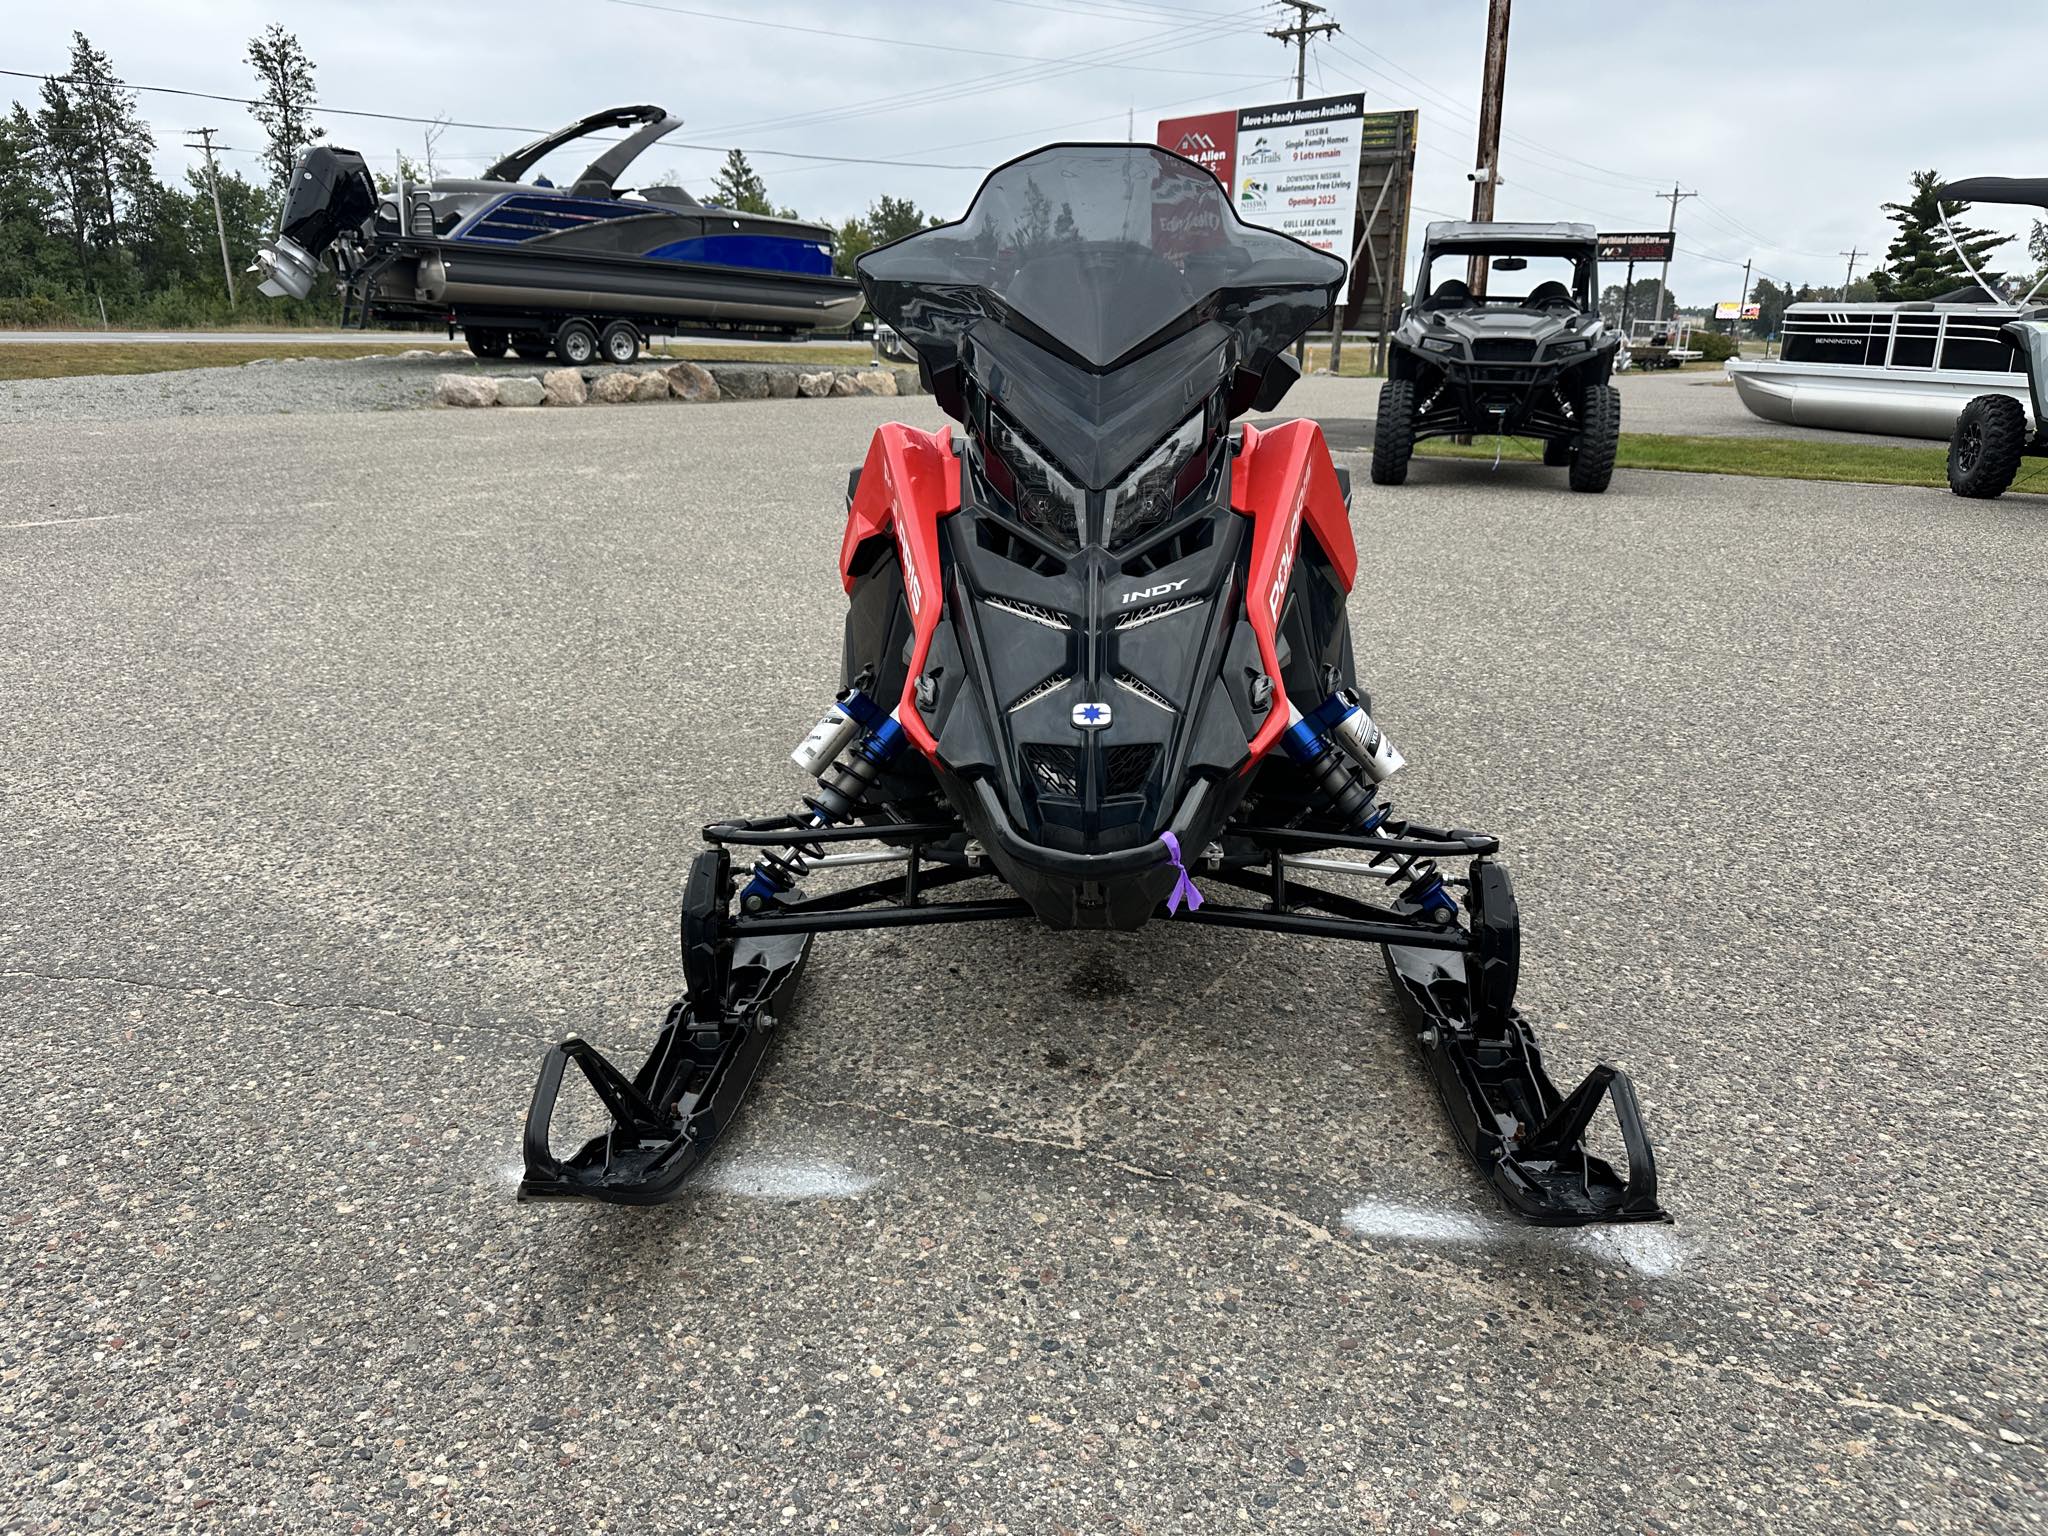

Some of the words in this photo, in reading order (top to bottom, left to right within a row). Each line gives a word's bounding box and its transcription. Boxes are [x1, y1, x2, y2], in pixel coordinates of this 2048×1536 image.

[1242, 111, 1294, 126] Move-in-Ready
[1295, 109, 1319, 120] Homes
[1321, 103, 1357, 117] Available
[1304, 127, 1329, 137] NISSWA
[1285, 140, 1304, 150] Single
[1305, 138, 1326, 148] Family
[1327, 136, 1349, 145] Homes
[1200, 150, 1226, 162] Allen
[1241, 155, 1259, 166] Pine
[1260, 152, 1281, 164] Trails
[1293, 152, 1298, 162] 9
[1300, 150, 1314, 161] Lots
[1315, 148, 1341, 159] remain
[1276, 183, 1316, 193] Maintenance
[1317, 181, 1331, 190] Free
[1331, 180, 1351, 191] Living
[1288, 196, 1317, 208] Opening
[1318, 194, 1336, 205] 2025
[1283, 220, 1299, 228] GULL
[1300, 219, 1315, 228] LAKE
[1316, 218, 1336, 227] CHAIN
[1308, 229, 1322, 237] Lake
[1323, 228, 1343, 236] Homes
[1269, 456, 1312, 624] POLARIS
[1122, 577, 1191, 604] INDY
